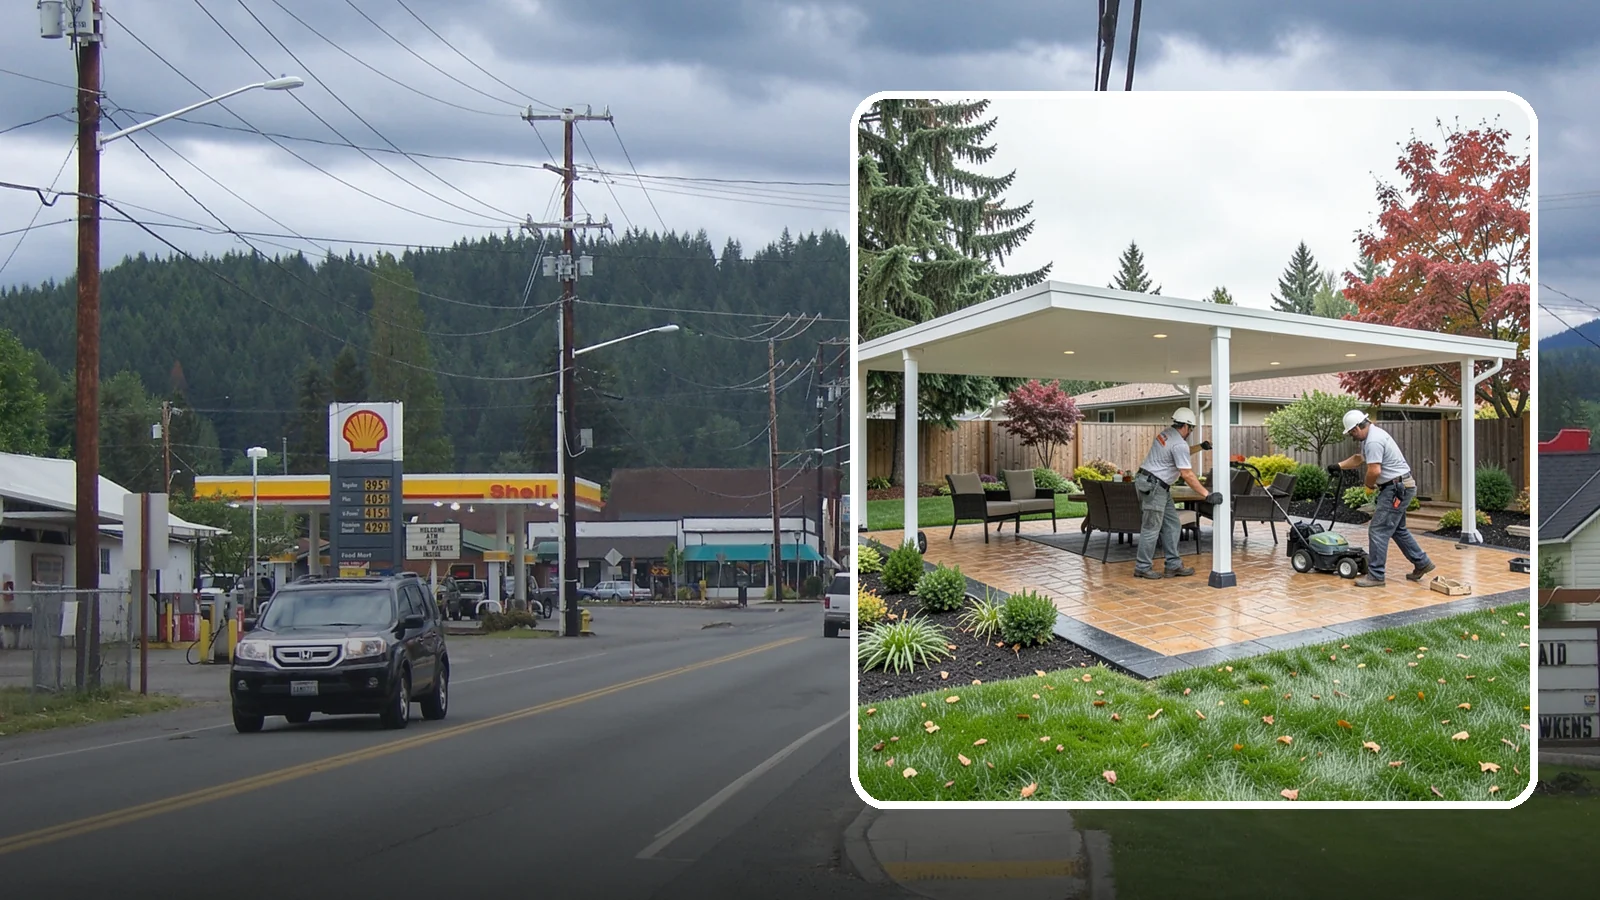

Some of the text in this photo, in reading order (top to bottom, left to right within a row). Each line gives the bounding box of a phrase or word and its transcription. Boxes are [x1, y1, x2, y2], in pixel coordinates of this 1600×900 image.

[365, 480, 384, 490] 395
[490, 484, 547, 499] Shell
[365, 494, 384, 504] 405
[365, 508, 384, 518] 415
[365, 522, 384, 532] 429
